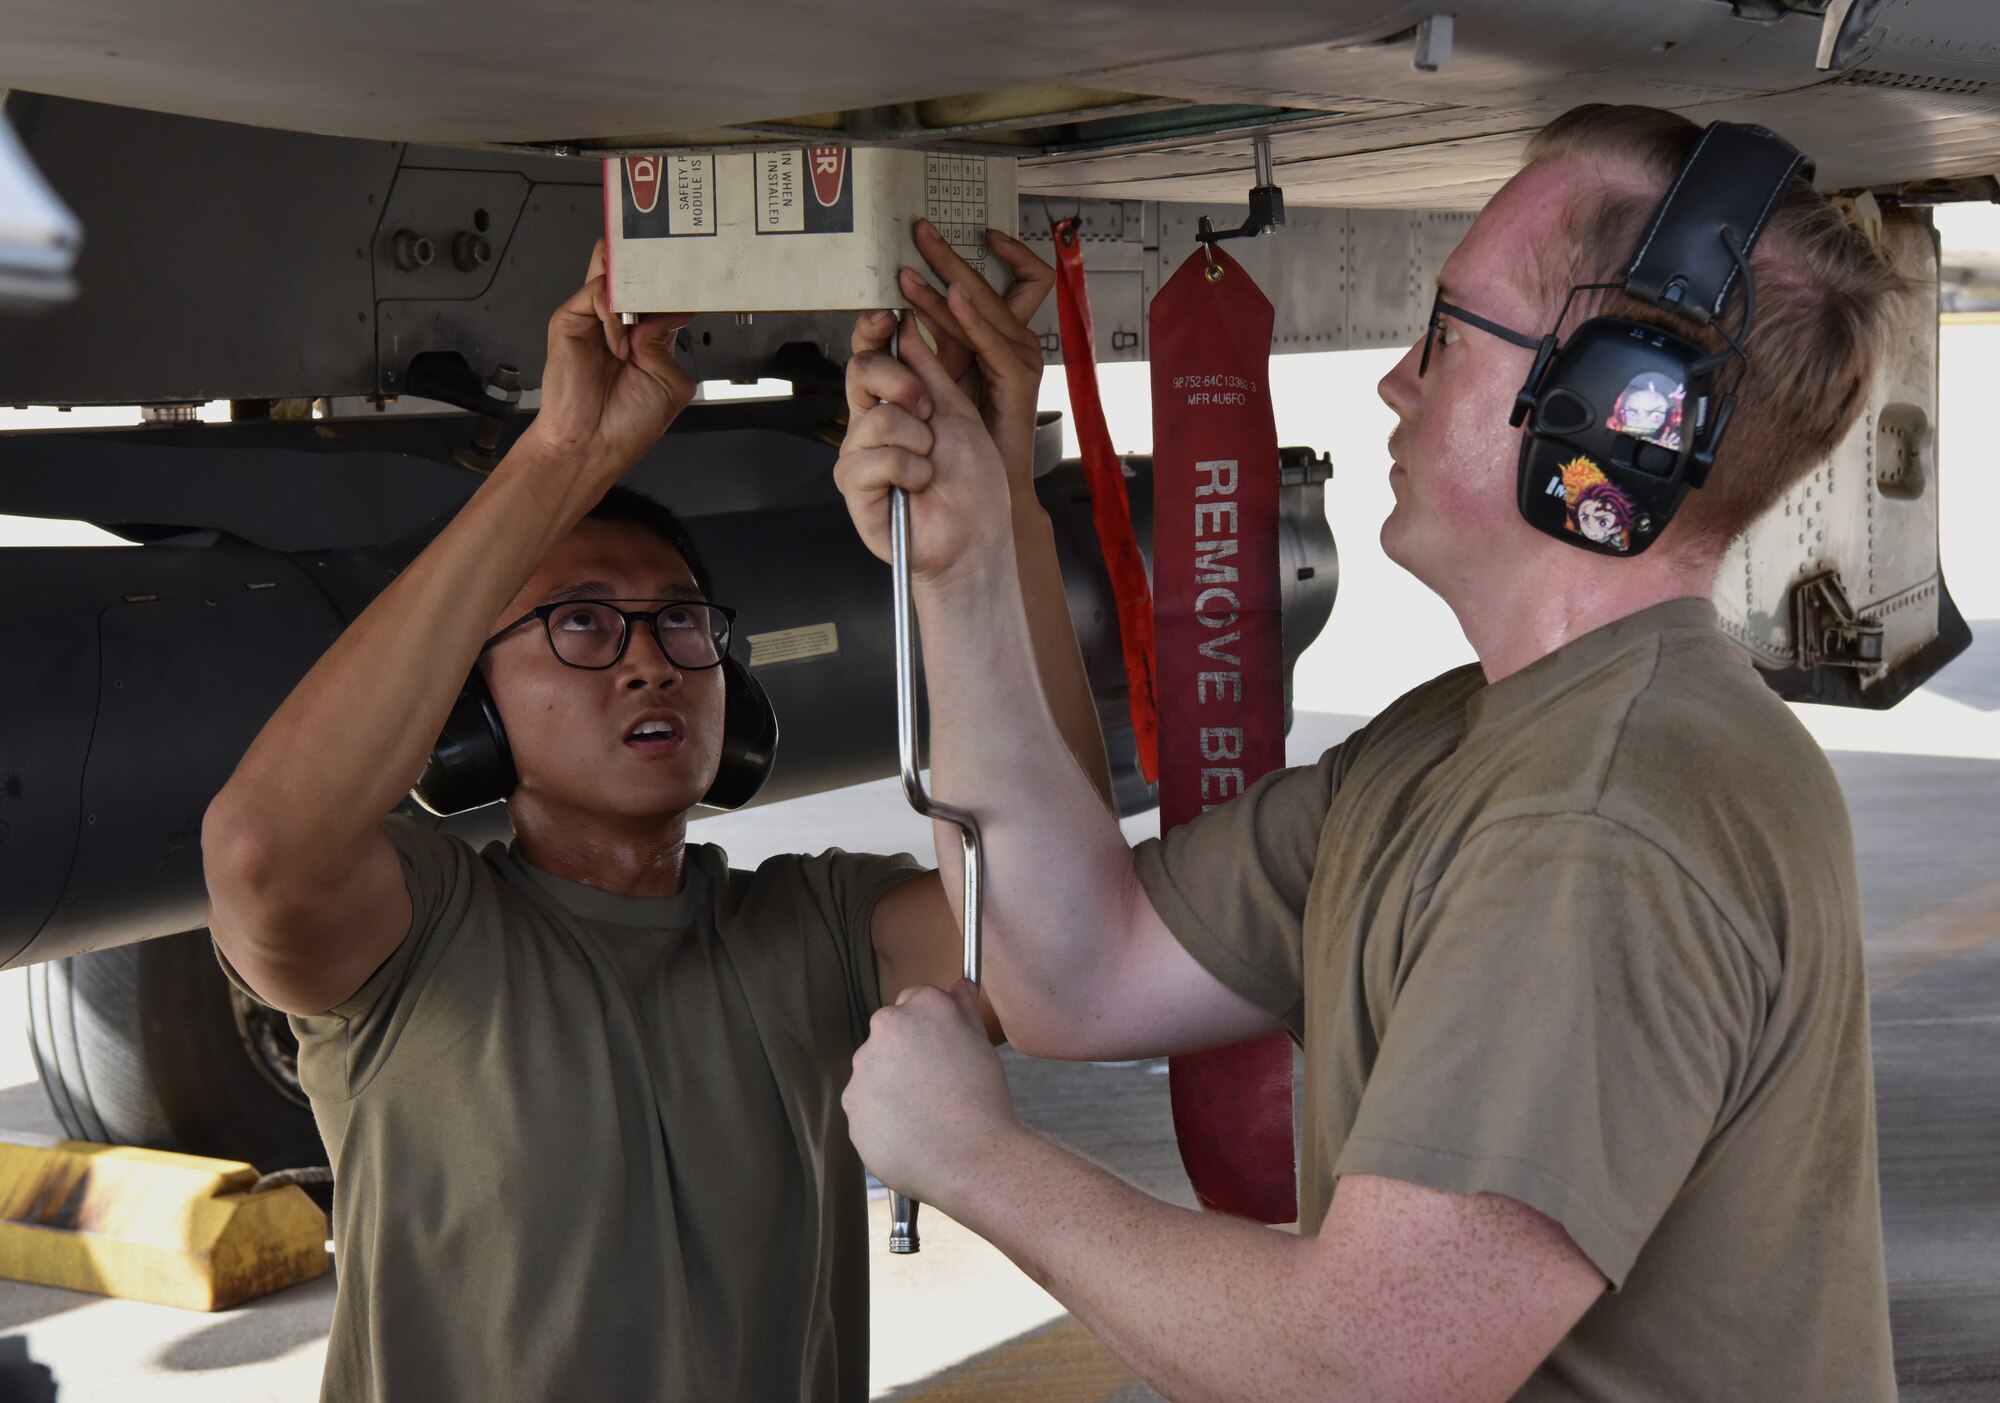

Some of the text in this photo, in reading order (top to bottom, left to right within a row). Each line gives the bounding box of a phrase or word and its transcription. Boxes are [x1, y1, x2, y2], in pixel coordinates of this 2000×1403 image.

[941, 164, 949, 173] 17
[953, 165, 960, 174] 11
[977, 166, 982, 175] 5
[679, 168, 689, 210] SAFETY
[692, 160, 703, 227] MODULE IS
[768, 160, 779, 225] INSTALLED
[782, 171, 793, 207] WHEN
[942, 186, 949, 194] 14
[953, 187, 960, 195] 23
[966, 187, 970, 196] 2
[976, 188, 983, 197] 20
[930, 207, 938, 216] 25
[954, 208, 961, 217] 10
[966, 209, 971, 217] 7
[976, 209, 984, 218] 28
[942, 229, 950, 238] 13
[954, 230, 961, 239] 22
[1187, 393, 1210, 406] MFR
[1194, 459, 1245, 813] REMOVE BE
